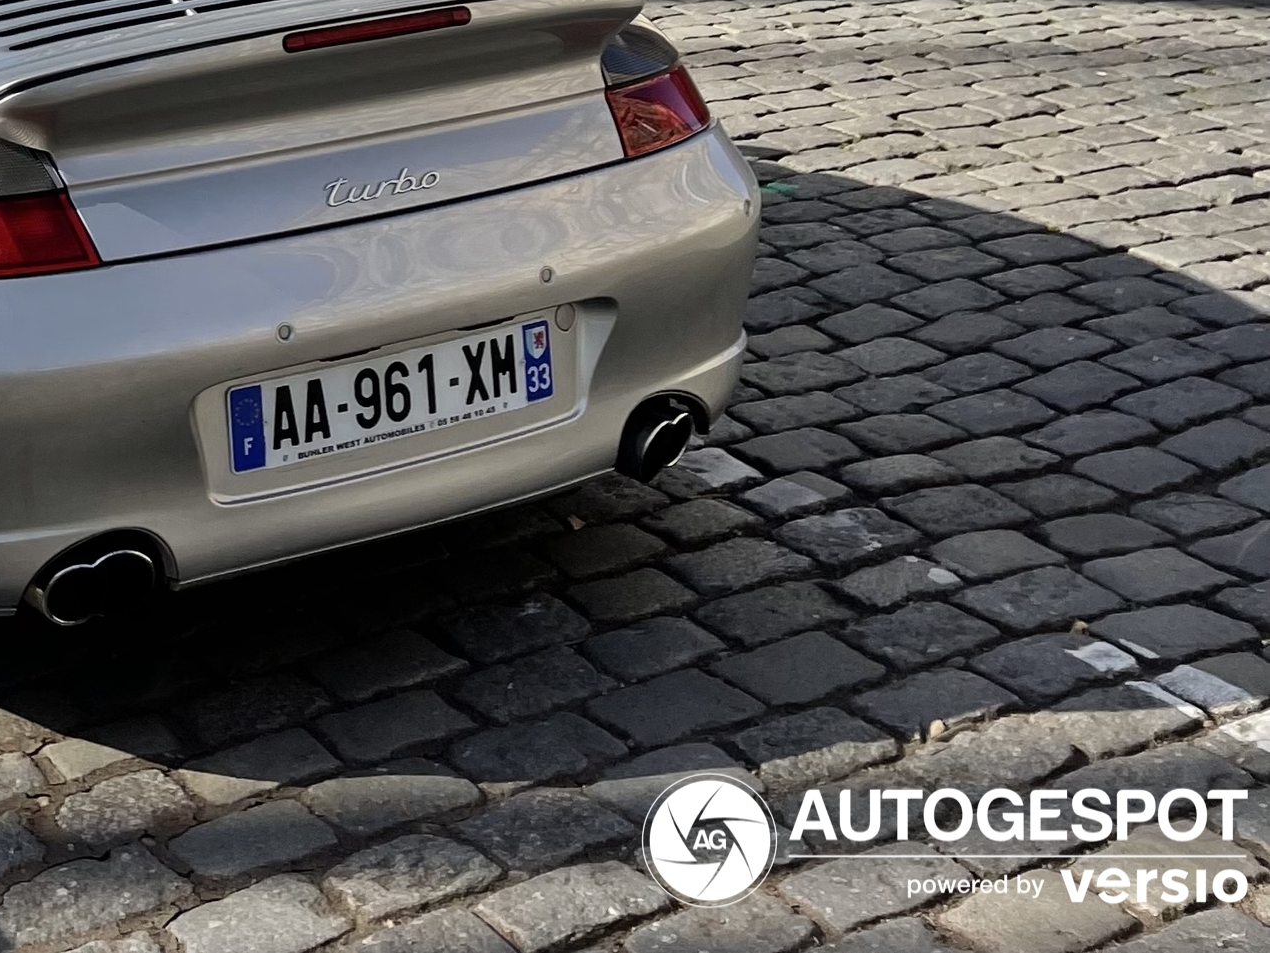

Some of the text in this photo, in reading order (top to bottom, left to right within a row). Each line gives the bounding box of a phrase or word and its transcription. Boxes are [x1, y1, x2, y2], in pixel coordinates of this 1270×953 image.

[324, 167, 441, 207] turbo
[272, 334, 518, 450] AA-961-XM
[527, 363, 552, 393] 33
[243, 436, 254, 456] F
[336, 438, 362, 451] WEST
[363, 423, 426, 445] AUTOMOBILES
